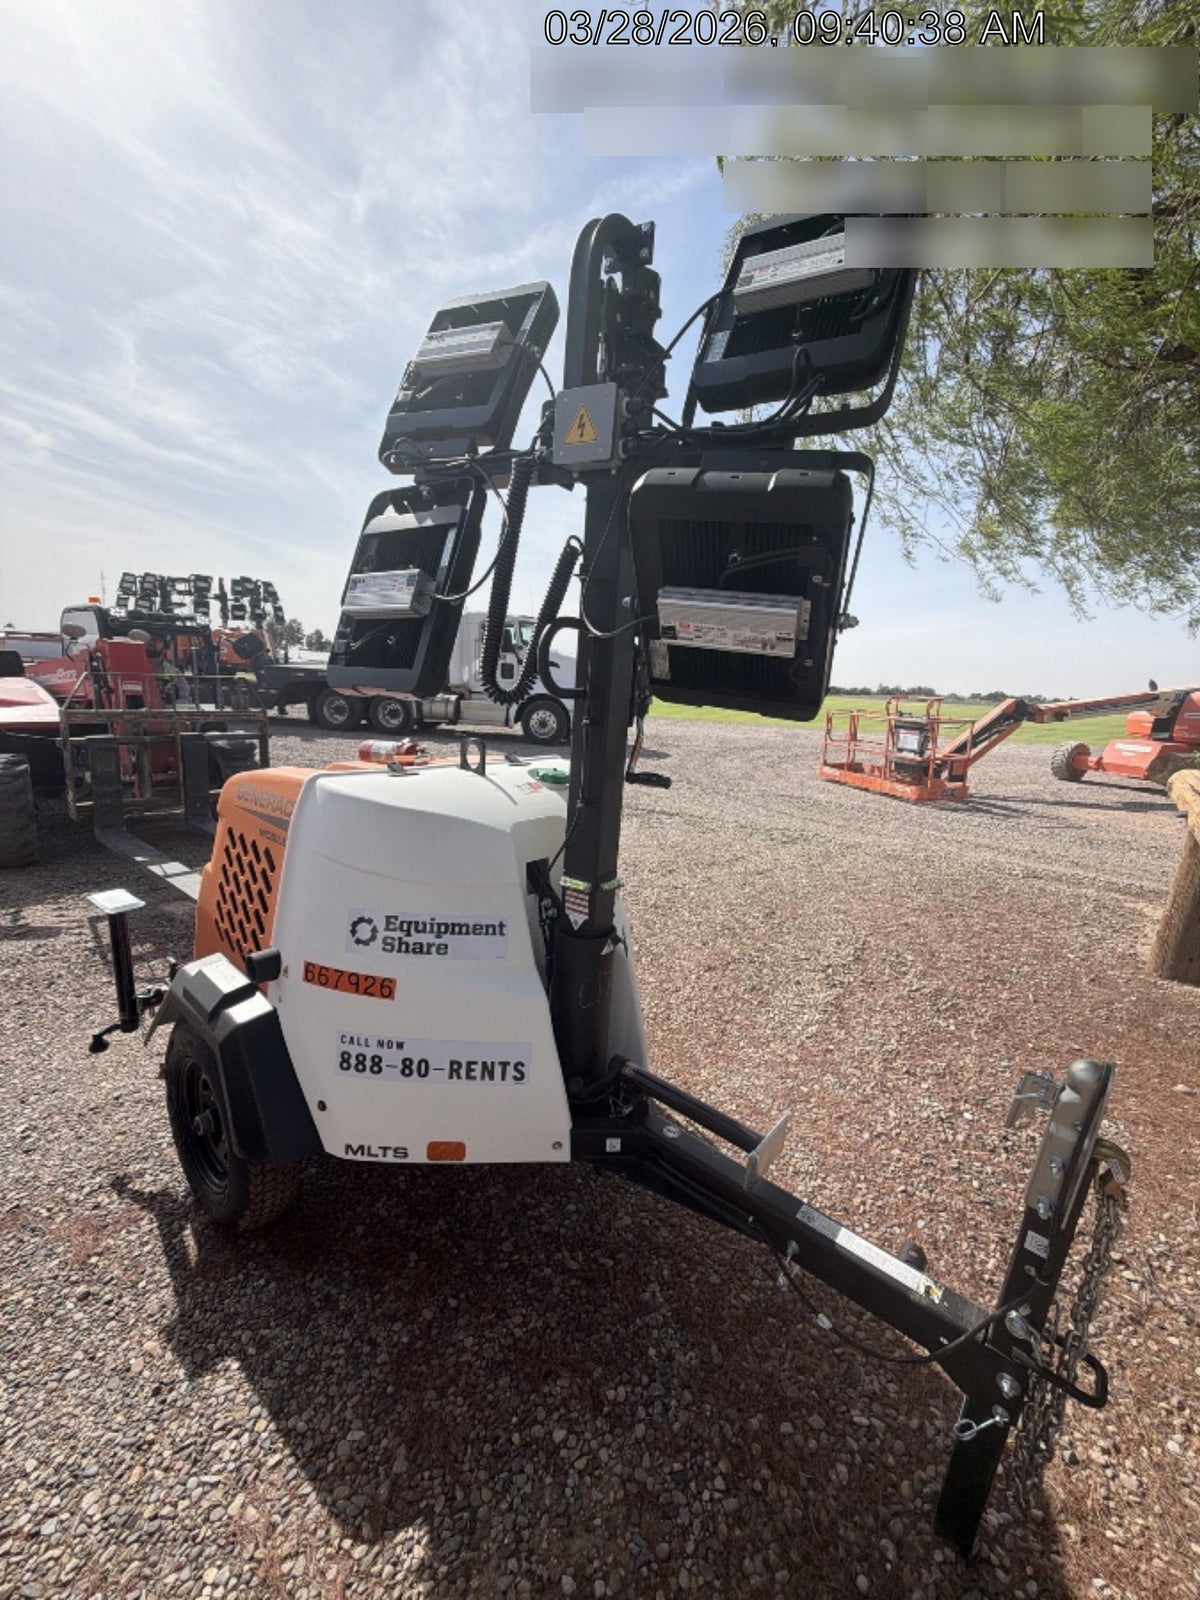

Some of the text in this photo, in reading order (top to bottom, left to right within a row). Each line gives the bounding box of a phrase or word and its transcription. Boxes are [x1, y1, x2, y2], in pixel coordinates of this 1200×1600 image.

[383, 914, 507, 939] Equipment
[381, 936, 449, 957] Share
[303, 962, 394, 999] 667926
[340, 1034, 405, 1051] CALL NOW
[338, 1050, 526, 1083] 888-80-RENTS
[344, 1143, 410, 1160] MLTS
